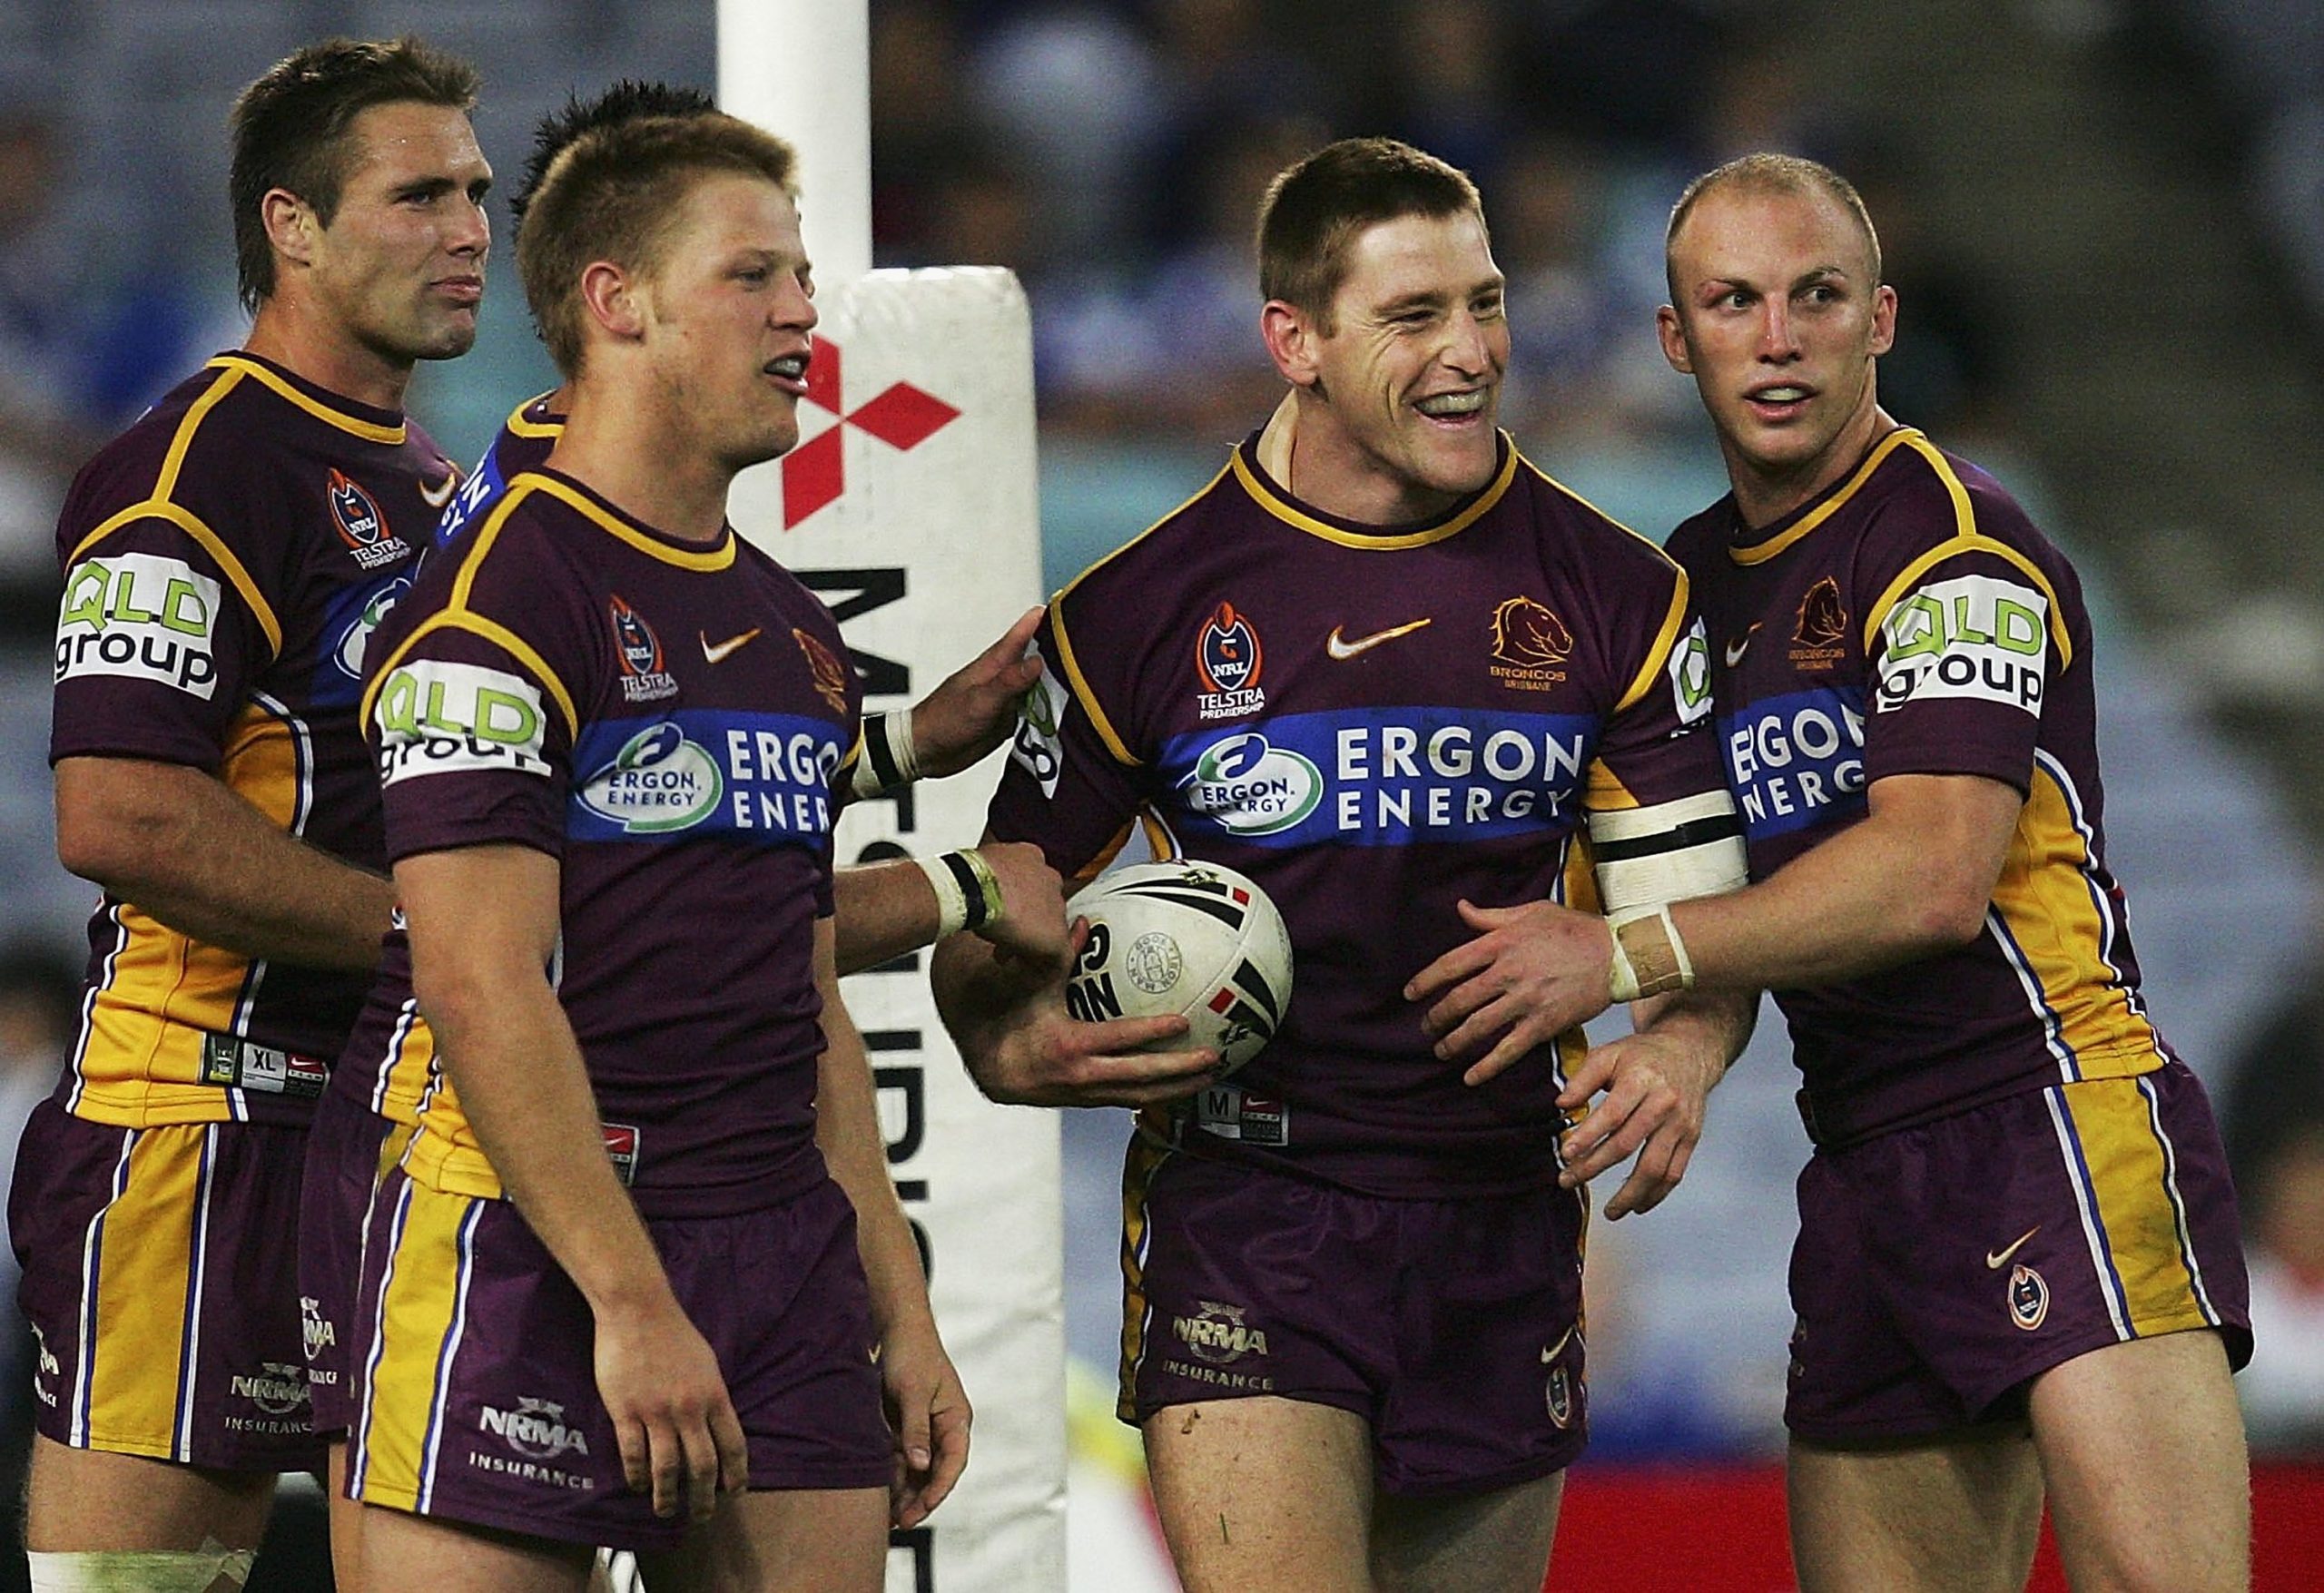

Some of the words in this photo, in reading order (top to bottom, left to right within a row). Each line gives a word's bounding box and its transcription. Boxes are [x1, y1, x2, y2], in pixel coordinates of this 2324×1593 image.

[350, 536, 408, 564] TELSTRA
[62, 560, 209, 637] QLD
[1887, 595, 2043, 664] QLD
[56, 633, 215, 688] group
[1213, 662, 1249, 677] NRL
[1490, 665, 1566, 682] BRONCOS
[619, 673, 678, 693] TELSTRA
[381, 670, 537, 744] QLD
[1196, 687, 1265, 710] TELSTRA
[1336, 726, 1584, 782] ERGON
[609, 771, 696, 790] ERGON
[1202, 778, 1288, 802] ERGON
[607, 791, 694, 806] ENERGY
[1337, 786, 1573, 831] ENERGY
[252, 1048, 277, 1072] XL
[1209, 1092, 1229, 1116] M
[1173, 1315, 1268, 1354] NRMA
[1163, 1360, 1274, 1391] INSURANCE
[479, 1405, 588, 1455] NRMA
[469, 1452, 595, 1490] INSURANCE
